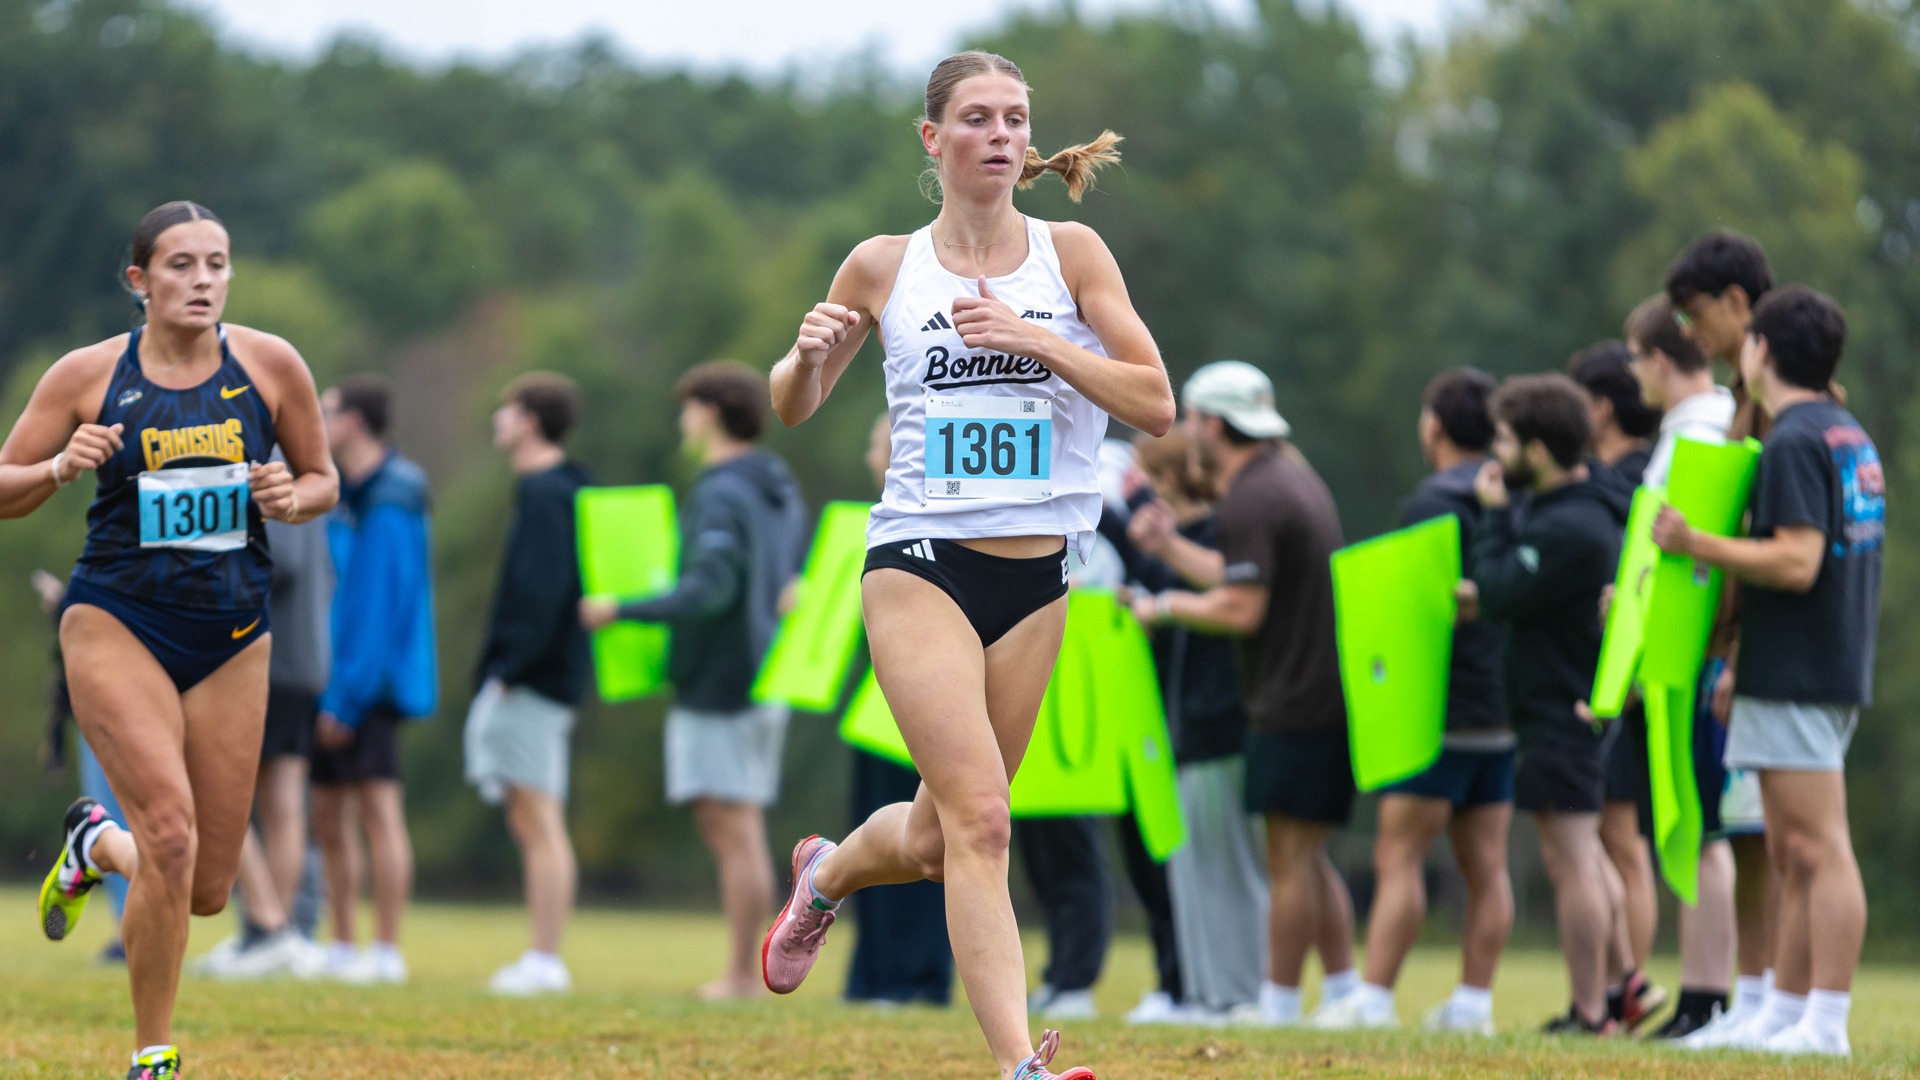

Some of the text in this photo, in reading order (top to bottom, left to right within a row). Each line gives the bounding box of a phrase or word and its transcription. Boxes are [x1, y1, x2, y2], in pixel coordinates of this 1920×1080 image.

[1020, 310, 1053, 319] A10
[923, 346, 1052, 385] Bonnies
[938, 422, 1039, 476] 1361
[152, 487, 240, 538] 1301
